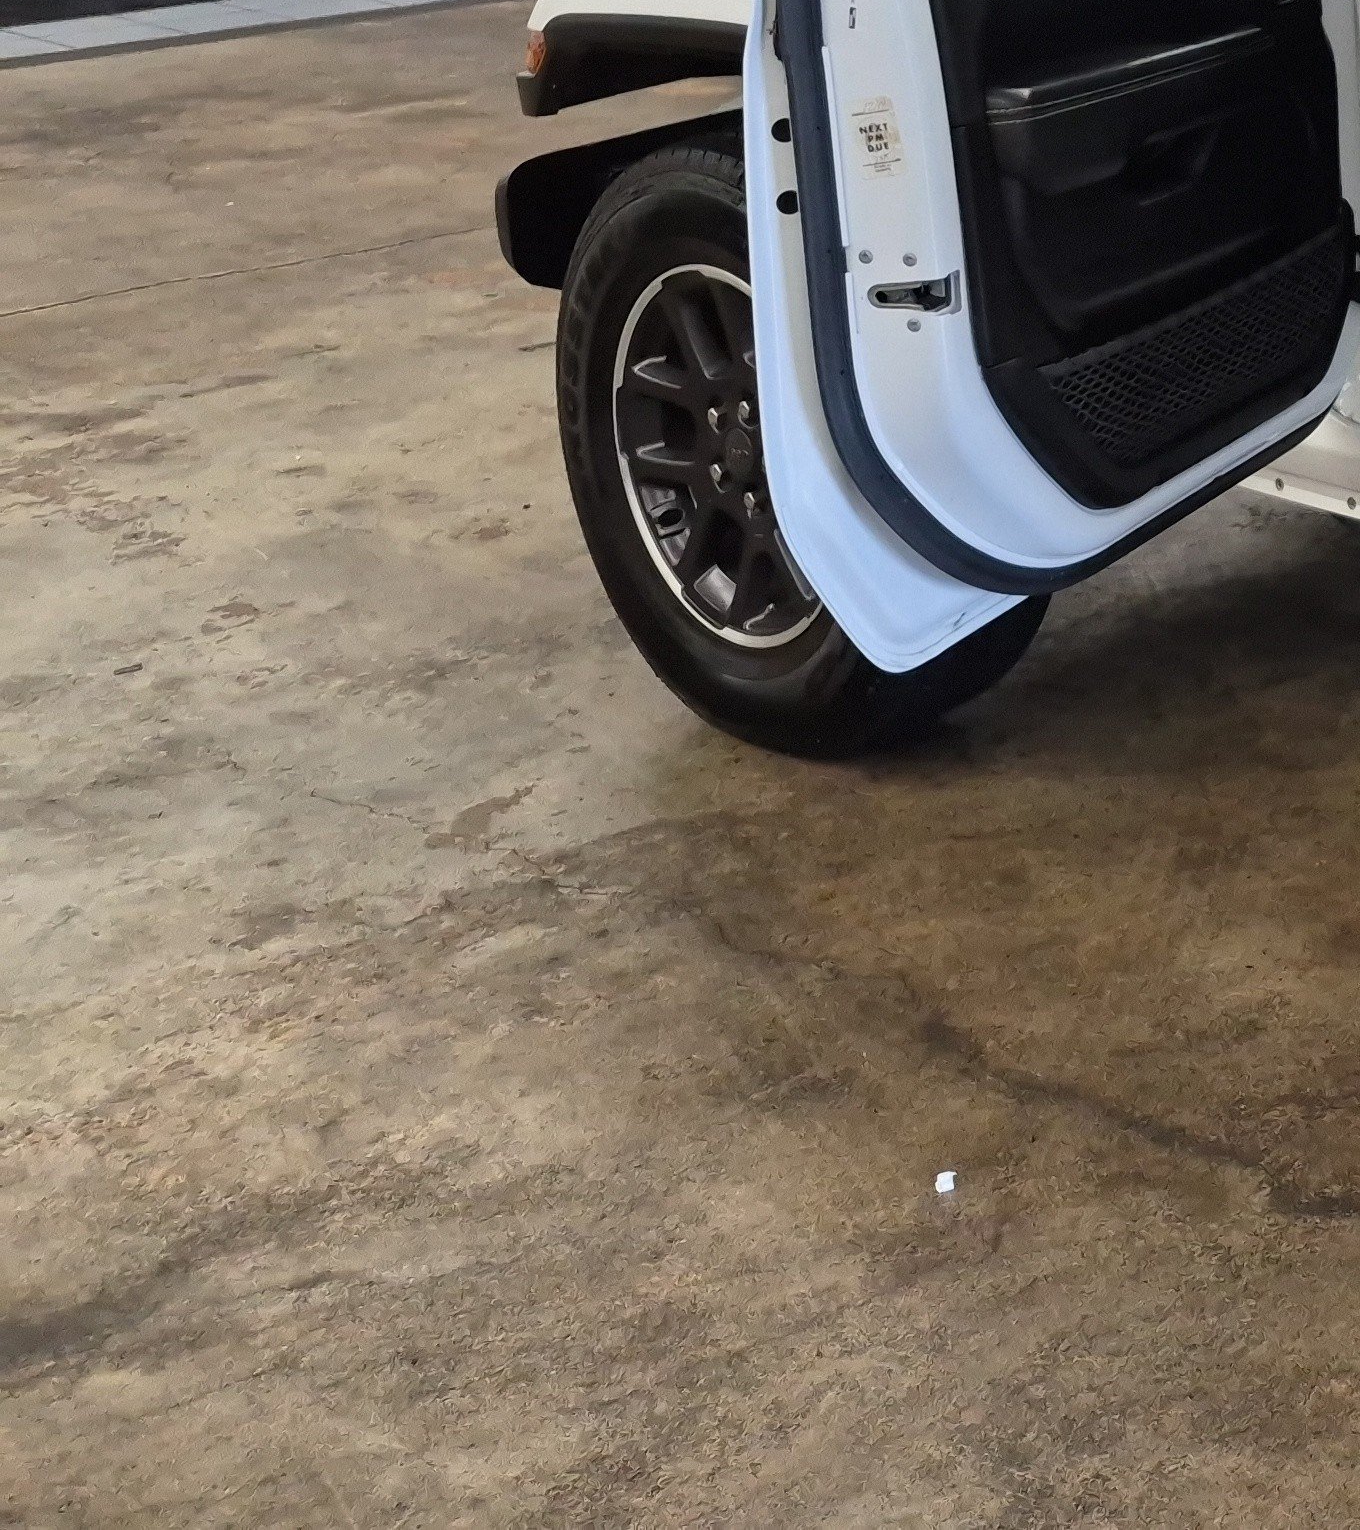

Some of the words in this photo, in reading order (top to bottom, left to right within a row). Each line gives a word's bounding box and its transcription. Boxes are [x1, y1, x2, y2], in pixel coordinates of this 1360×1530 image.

[858, 122, 888, 135] NEXT
[867, 133, 885, 143] PM
[867, 142, 890, 153] DUE
